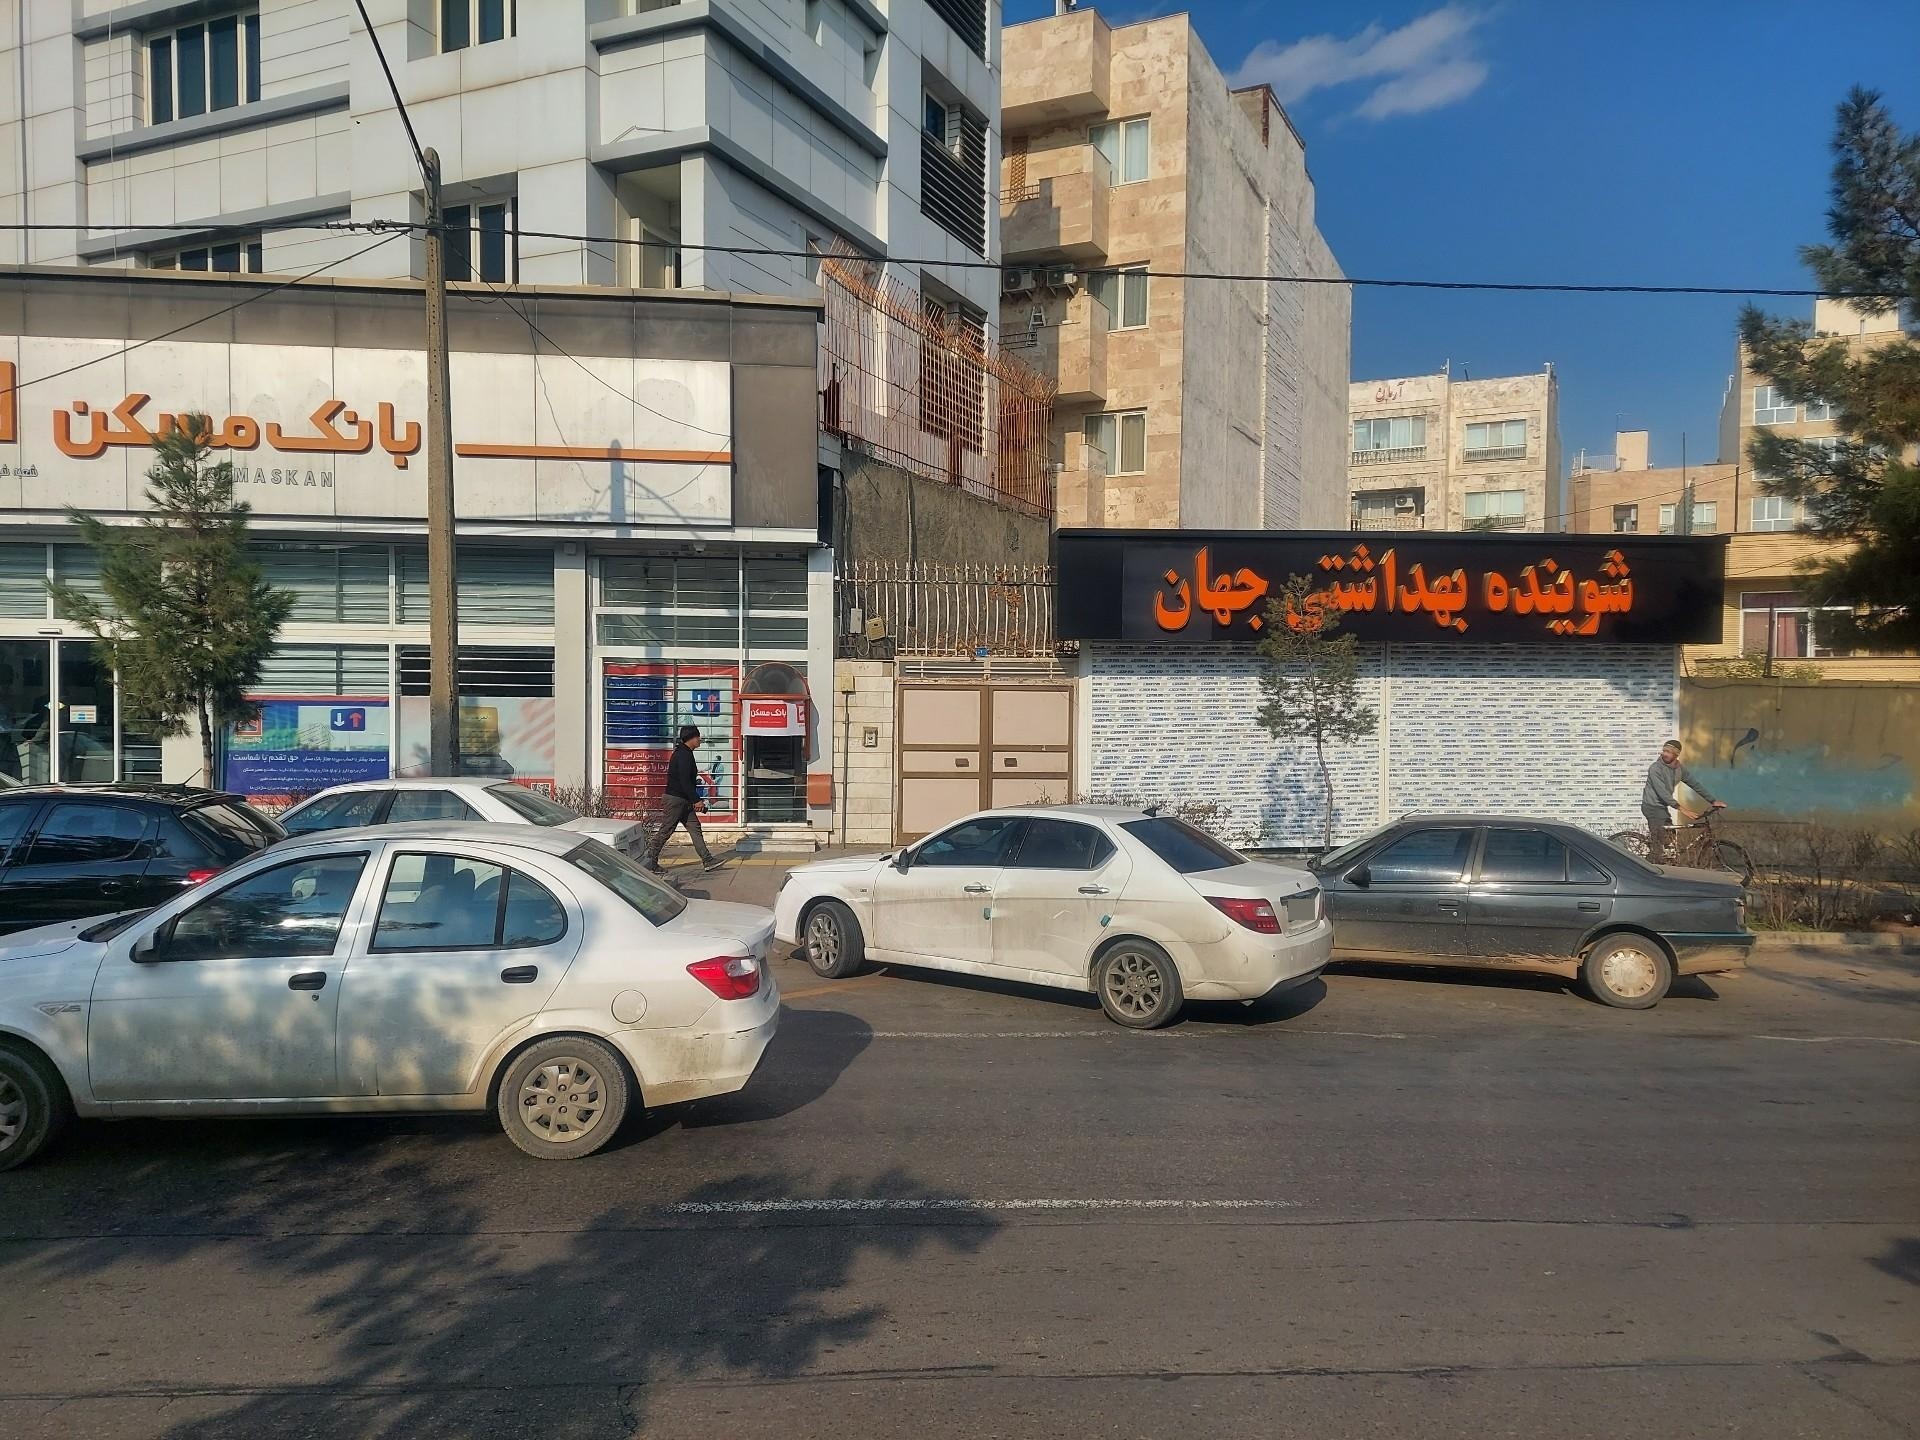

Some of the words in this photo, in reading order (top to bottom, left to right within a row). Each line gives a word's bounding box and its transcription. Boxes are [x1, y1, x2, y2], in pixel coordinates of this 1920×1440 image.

[53, 393, 260, 457] مسکن
[265, 400, 421, 469] بانک
[233, 467, 333, 487] MASKAN
[1153, 546, 1270, 631] جهان
[1285, 543, 1469, 634] بهداشتی
[1485, 549, 1634, 635] شوینده
[750, 708, 771, 718] مسکن
[770, 708, 787, 718] بانک
[232, 753, 261, 761] شماست
[268, 753, 287, 763] تقدم
[288, 755, 299, 763] حق
[608, 763, 635, 772] بسازیم
[635, 763, 651, 773] بهتر
